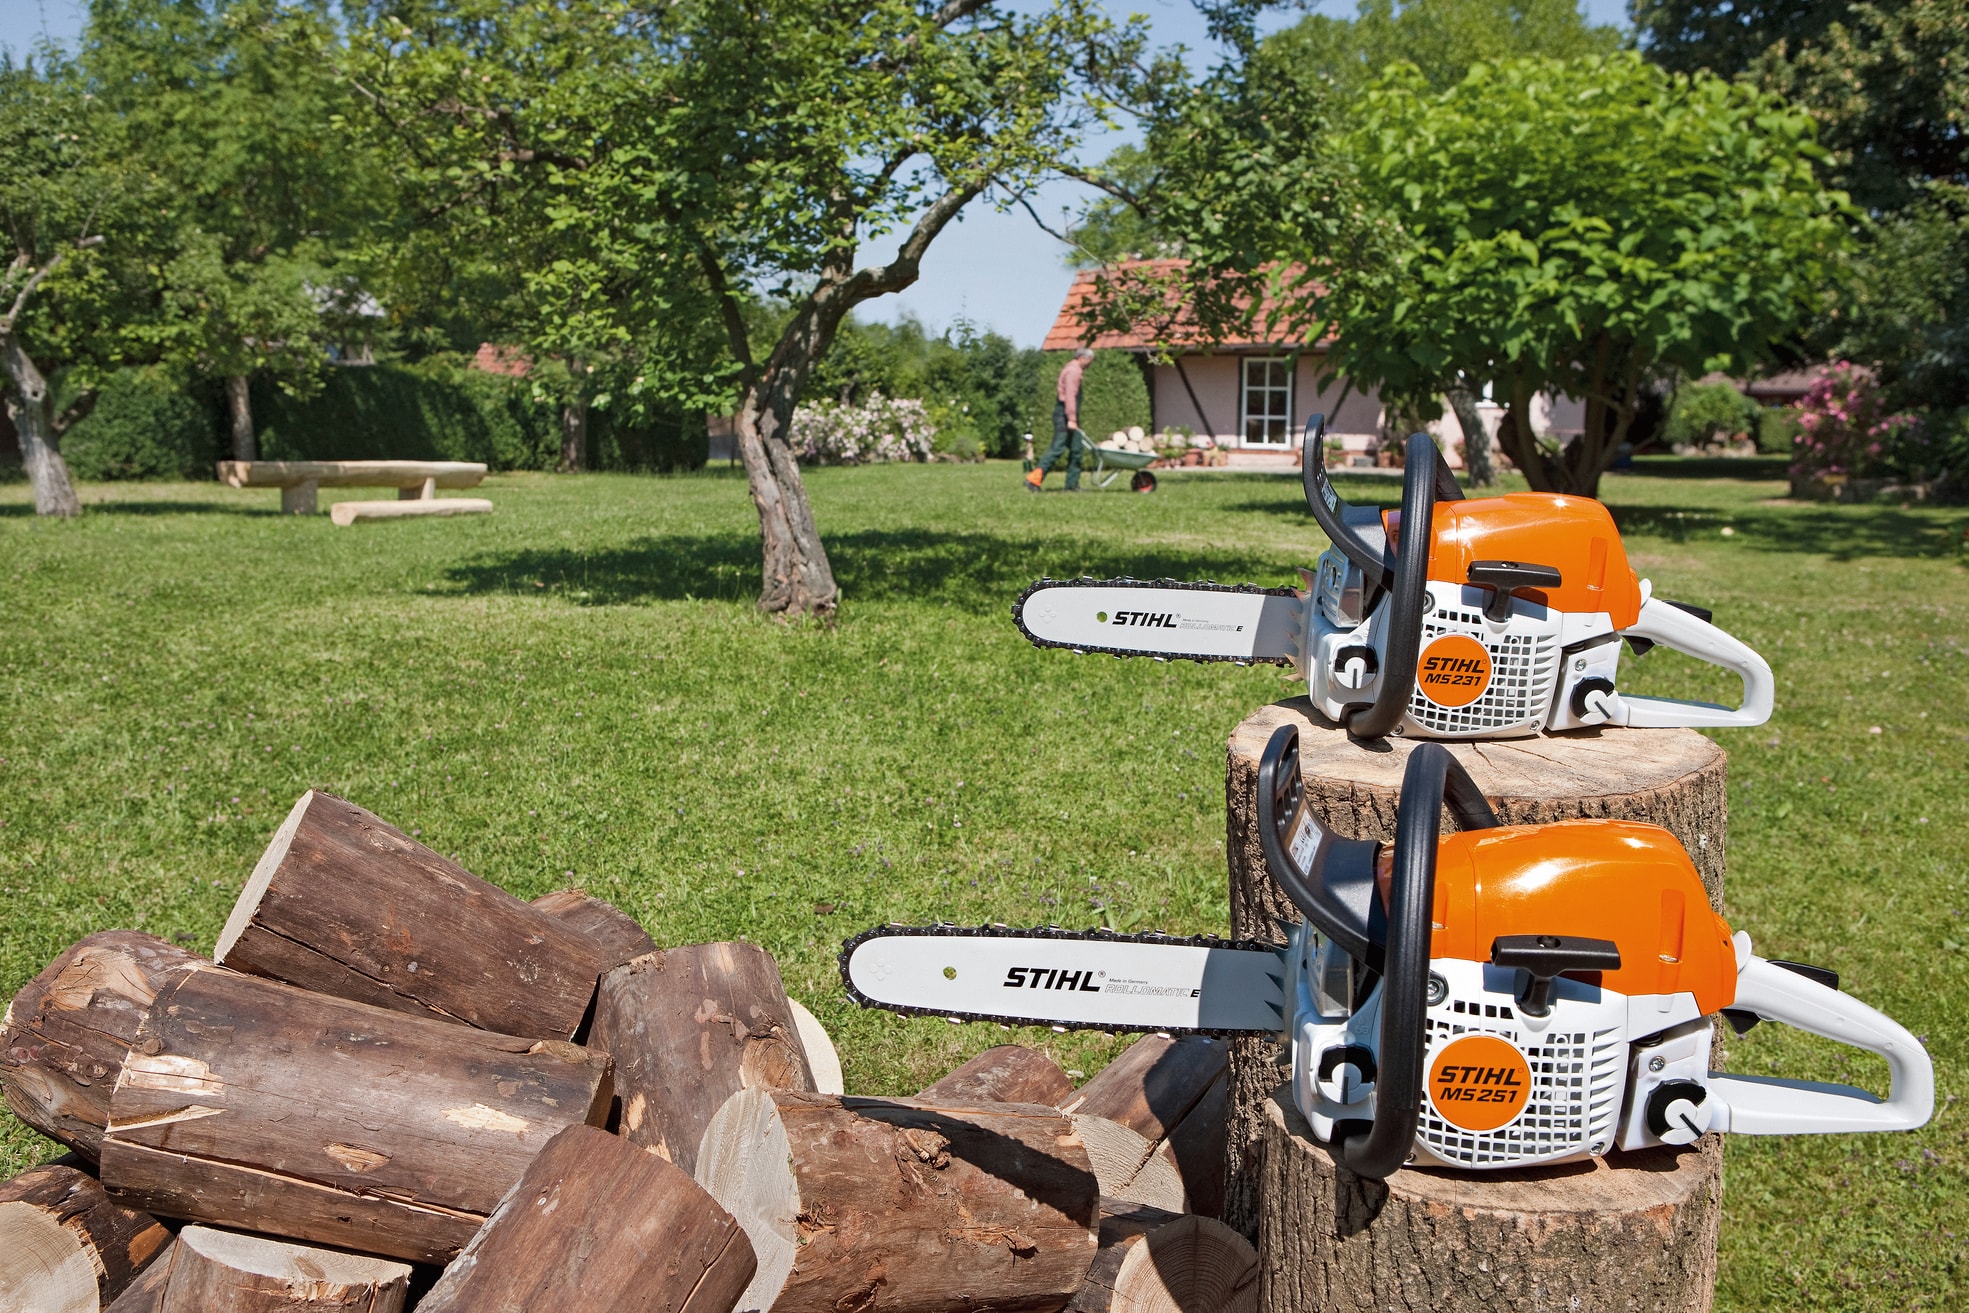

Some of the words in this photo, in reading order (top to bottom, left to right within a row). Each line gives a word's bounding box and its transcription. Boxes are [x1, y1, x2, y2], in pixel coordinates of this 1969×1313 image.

[1112, 611, 1177, 628] STIHL
[1424, 657, 1484, 673] STIHL
[1003, 967, 1100, 992] STIHL
[1105, 984, 1190, 997] ROLLOMATIC
[1190, 989, 1201, 998] E
[1437, 1066, 1521, 1086] STIHL
